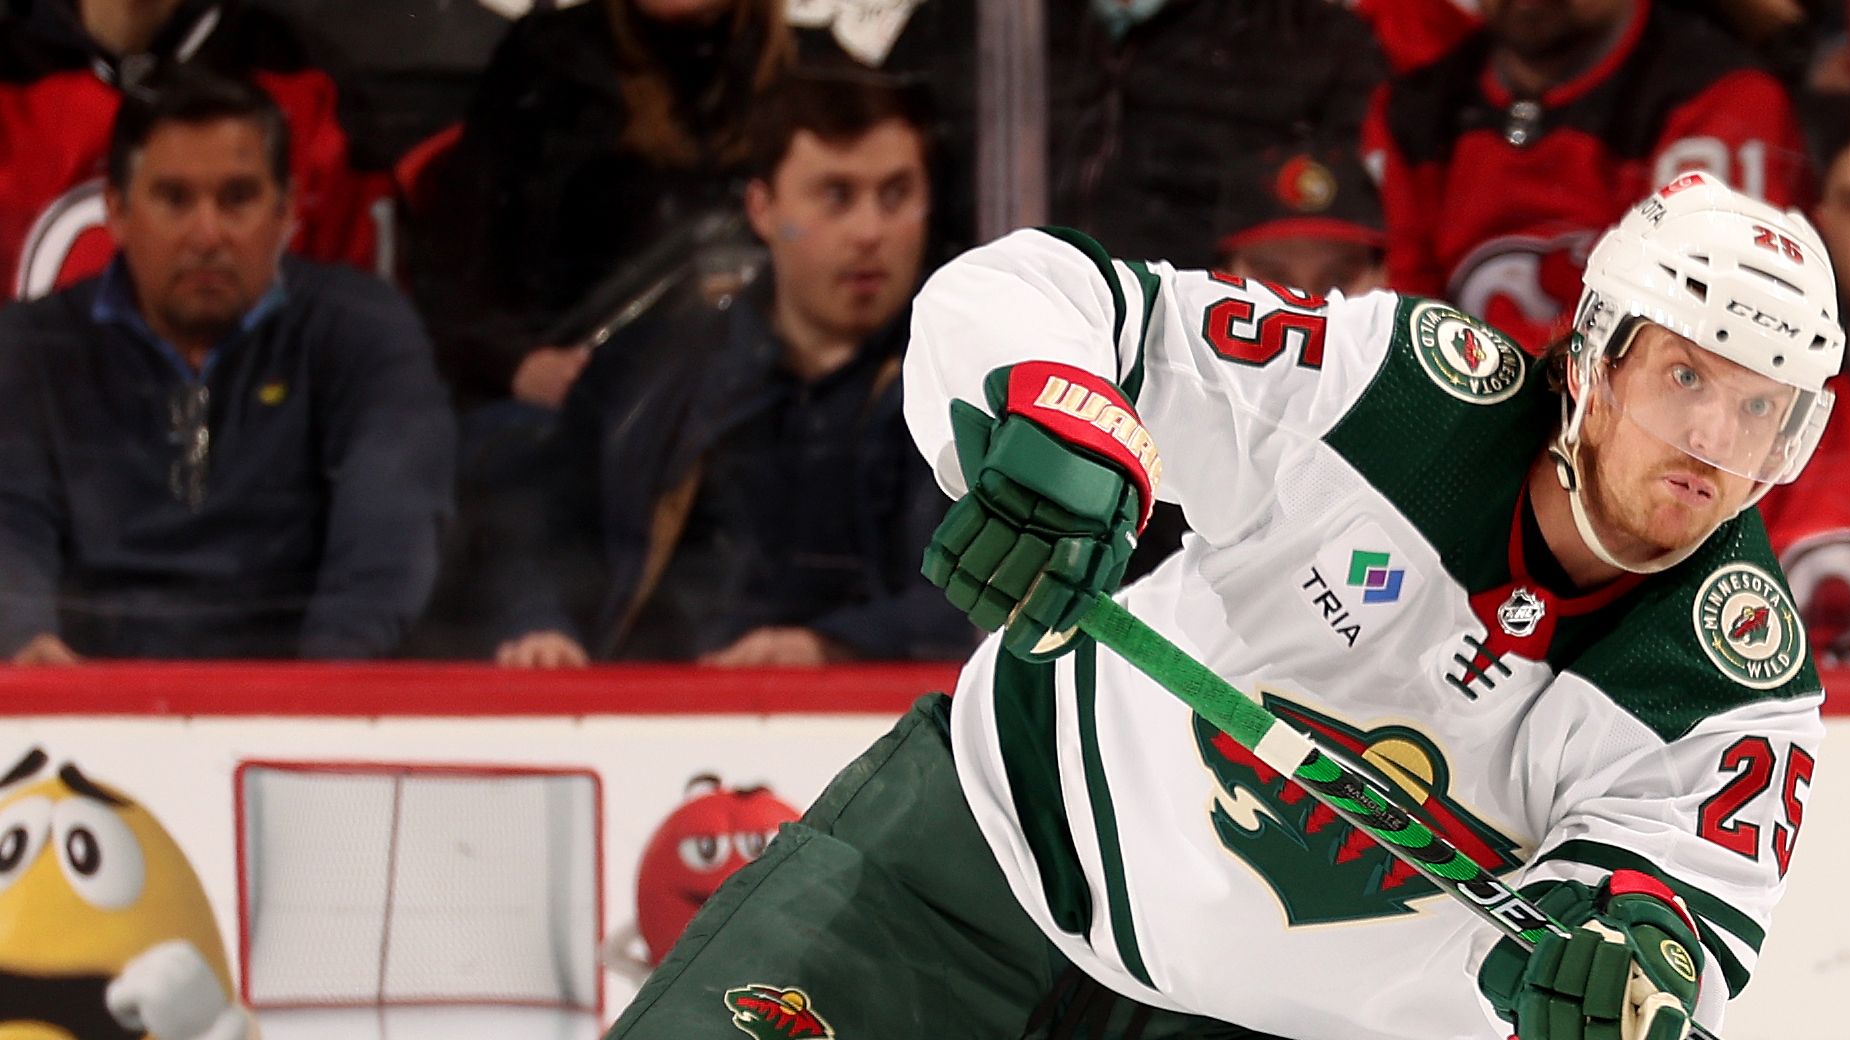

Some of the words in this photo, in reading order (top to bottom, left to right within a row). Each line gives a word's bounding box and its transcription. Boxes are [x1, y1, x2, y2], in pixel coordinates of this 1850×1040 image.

[1420, 310, 1442, 348] WILD
[1726, 299, 1801, 338] CCM
[1302, 566, 1361, 648] TRIA
[1703, 573, 1780, 630] MINNESOTA
[1746, 653, 1790, 678] WILD
[1697, 734, 1815, 882] 25
